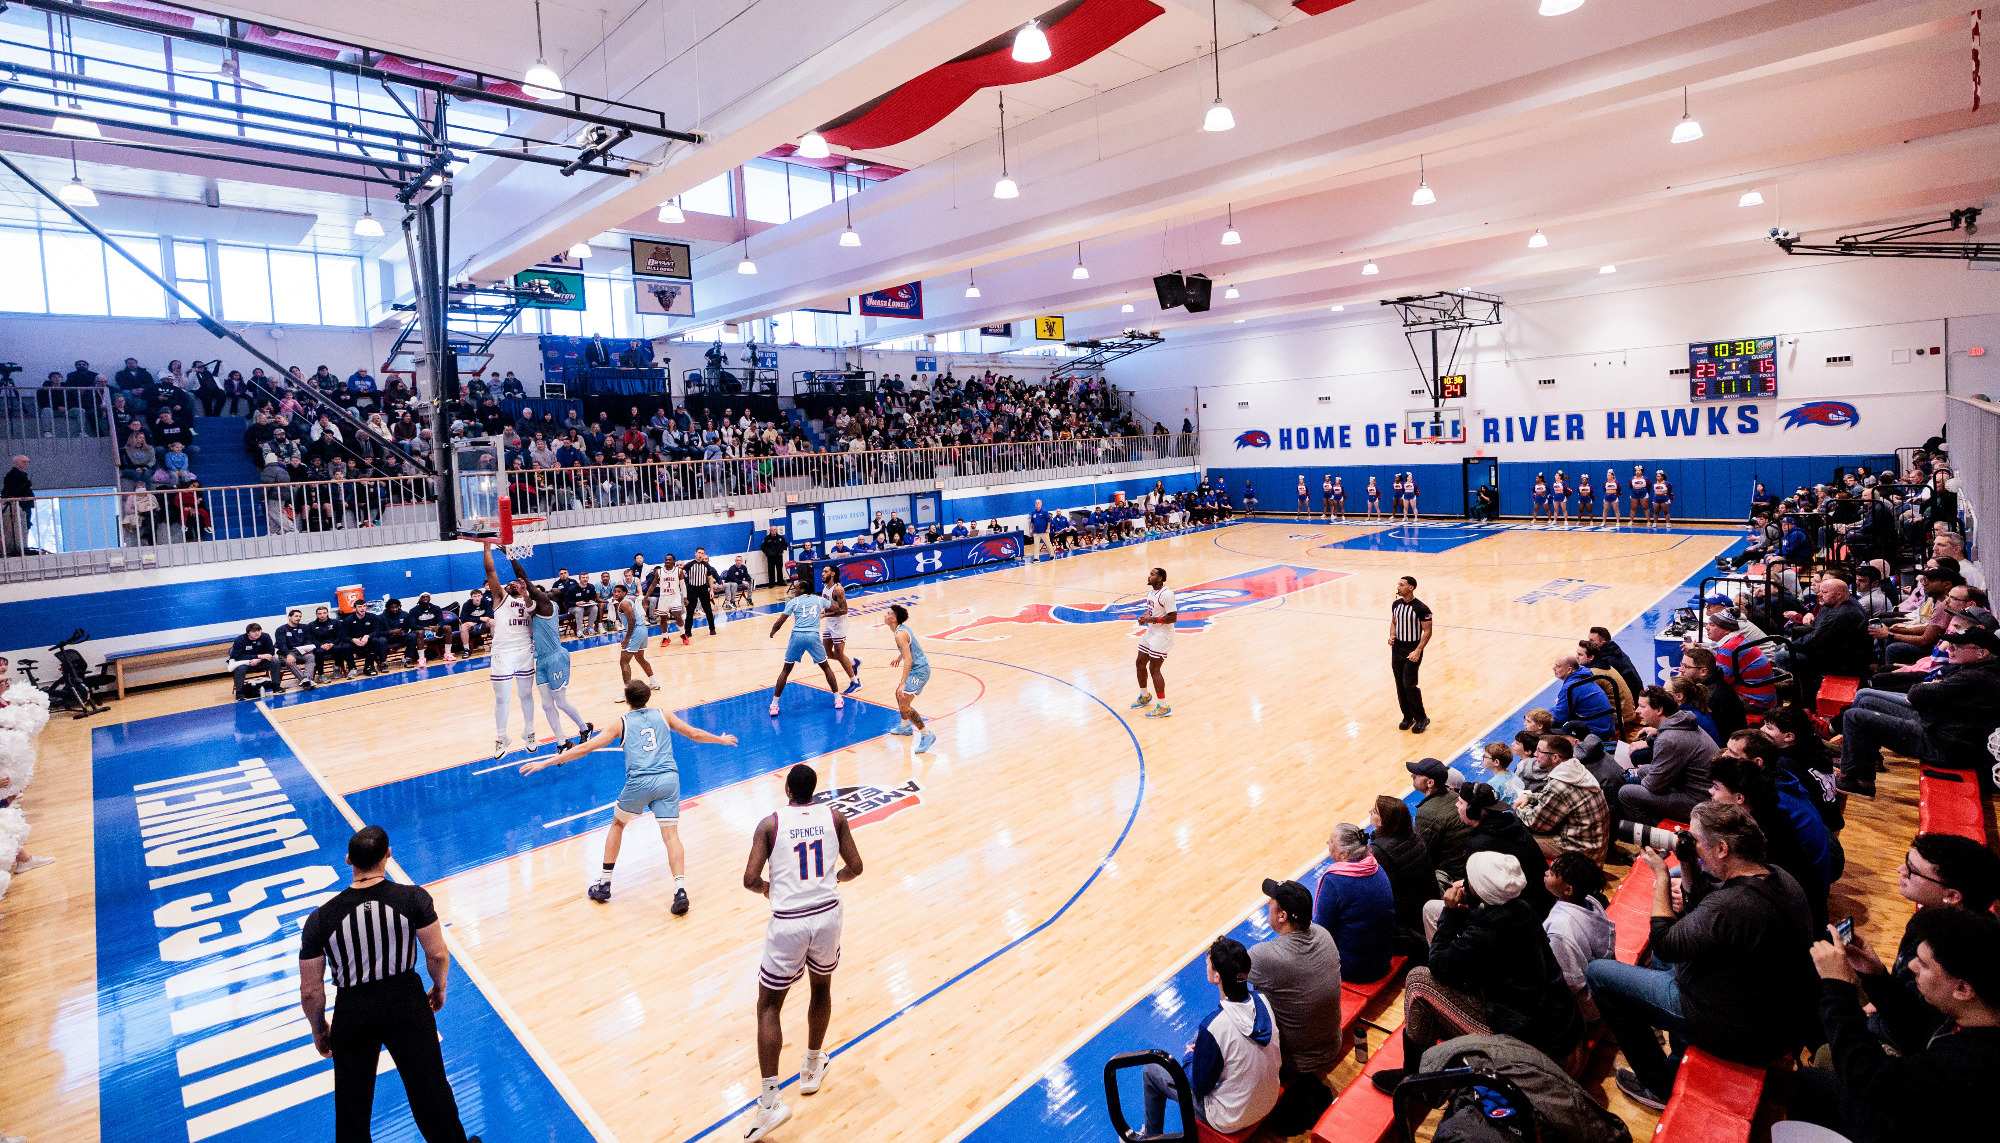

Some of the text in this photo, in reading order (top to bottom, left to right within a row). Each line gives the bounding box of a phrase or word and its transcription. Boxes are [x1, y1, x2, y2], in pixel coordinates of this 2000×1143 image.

[1714, 340, 1756, 357] 10:38
[766, 357, 772, 368] 4
[924, 362, 930, 371] 4
[1731, 362, 1736, 370] 1
[1759, 358, 1775, 373] 15
[1696, 363, 1717, 378] 23
[1444, 376, 1463, 384] 10:38
[1747, 379, 1751, 392] 1
[1766, 377, 1775, 392] 3
[1445, 384, 1460, 397] 24
[1696, 382, 1706, 396] 2
[1279, 425, 1351, 451] HOME
[1366, 423, 1397, 447] OF
[1483, 413, 1585, 443] RIVER
[1606, 404, 1759, 440] HAWKS
[518, 608, 525, 618] 9
[800, 604, 818, 618] 14
[553, 670, 563, 680] M
[910, 676, 920, 685] M
[640, 727, 657, 752] 3
[789, 825, 825, 840] SPENCER
[793, 838, 824, 881] 11
[133, 757, 443, 1143] UMASS LOWELL
